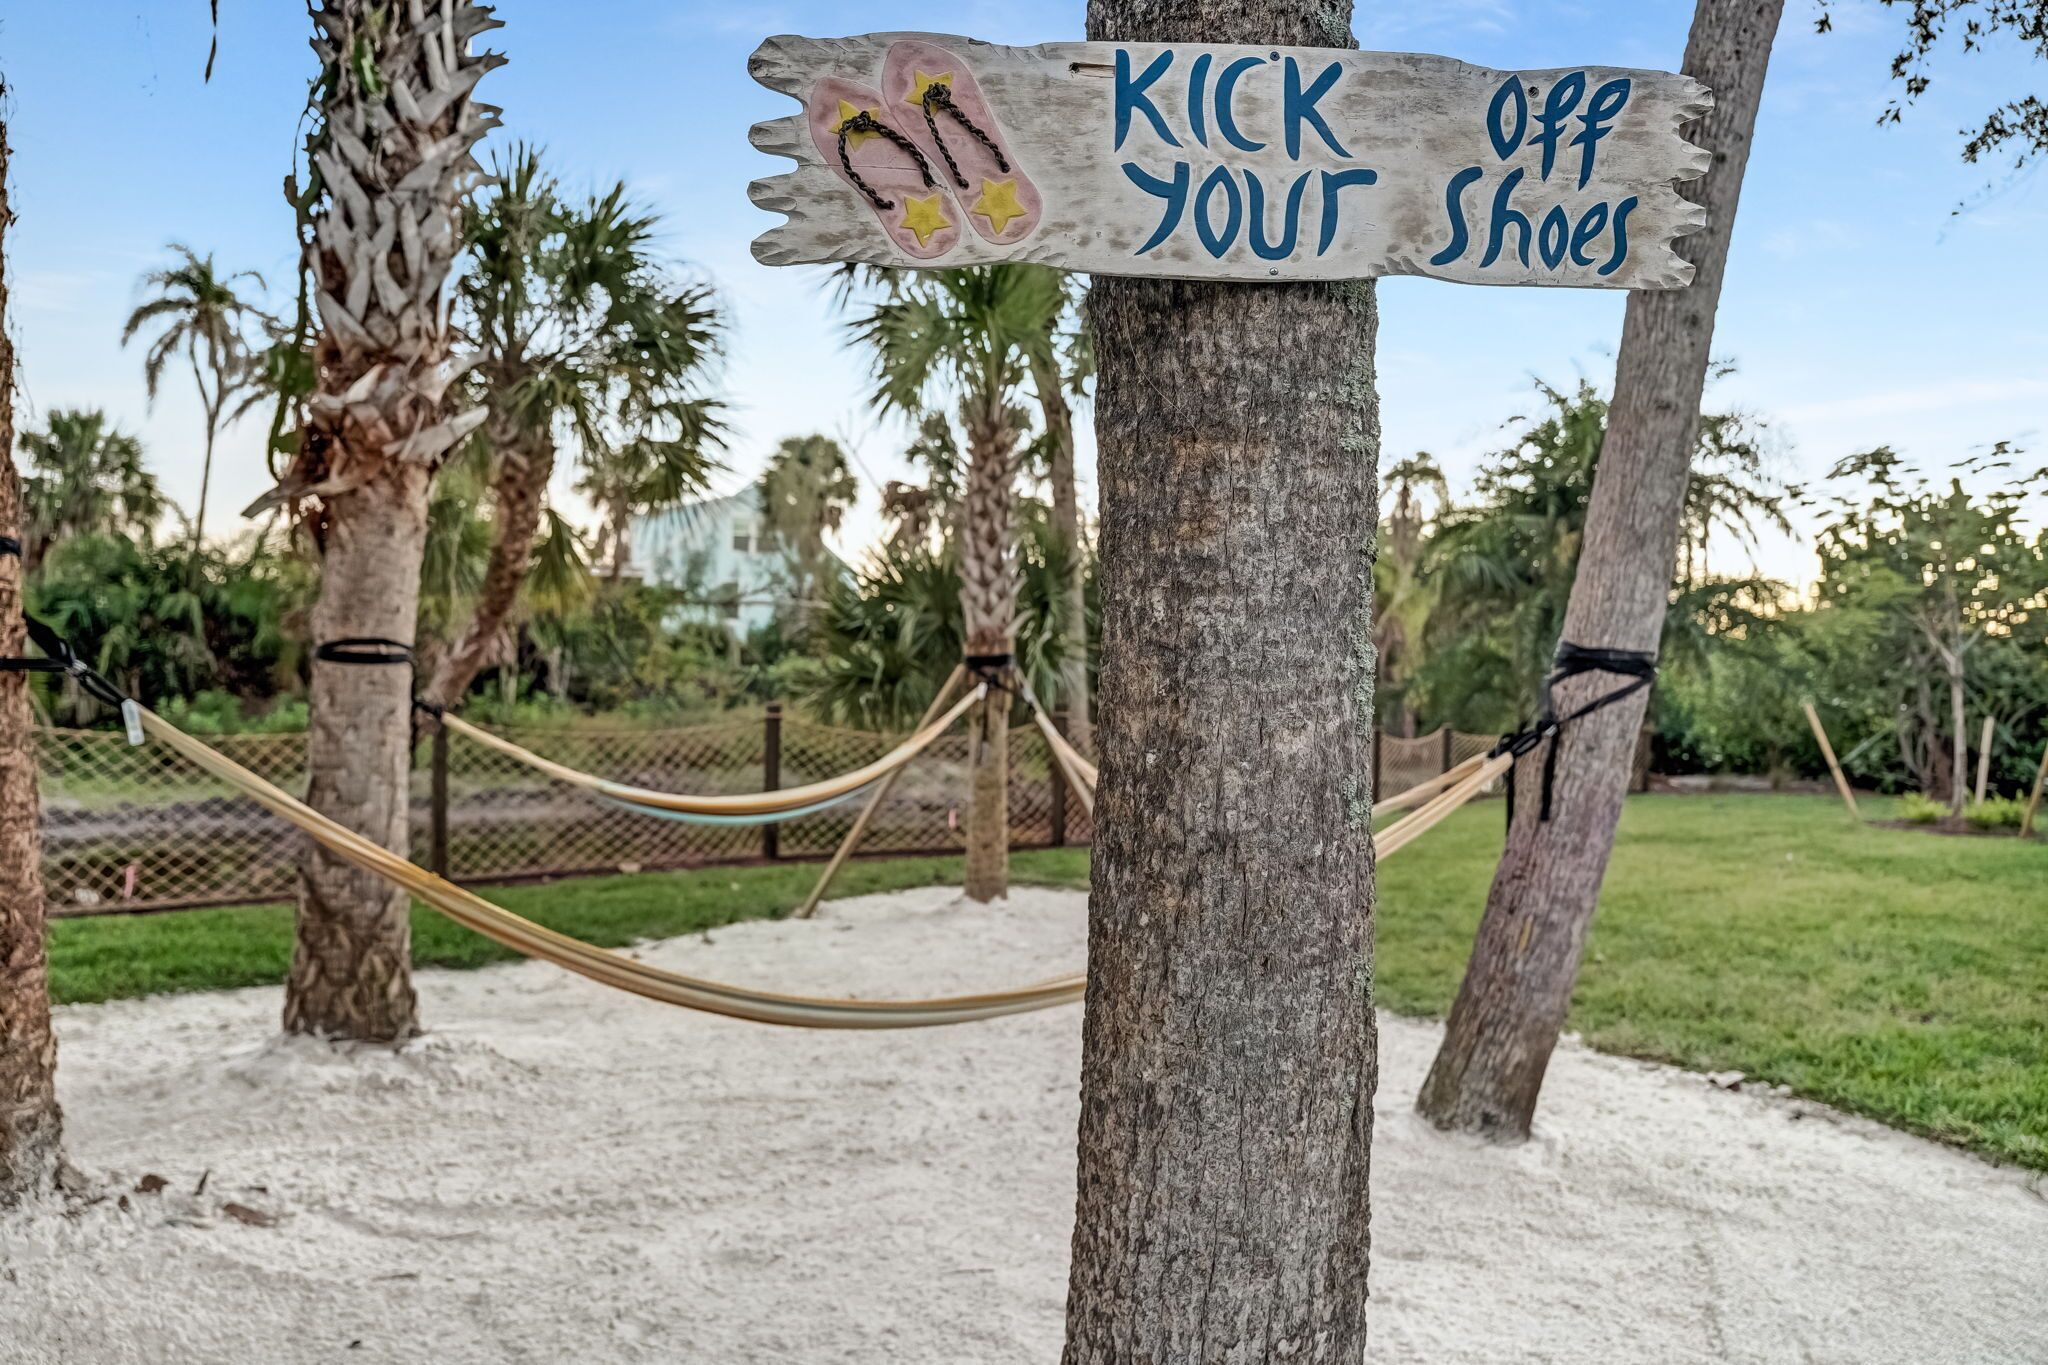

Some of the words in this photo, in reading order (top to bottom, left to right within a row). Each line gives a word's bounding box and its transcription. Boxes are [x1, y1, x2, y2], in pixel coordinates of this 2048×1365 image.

[1115, 48, 1353, 160] KICK
[1486, 70, 1631, 190] Off
[1429, 166, 1638, 276] Shoes
